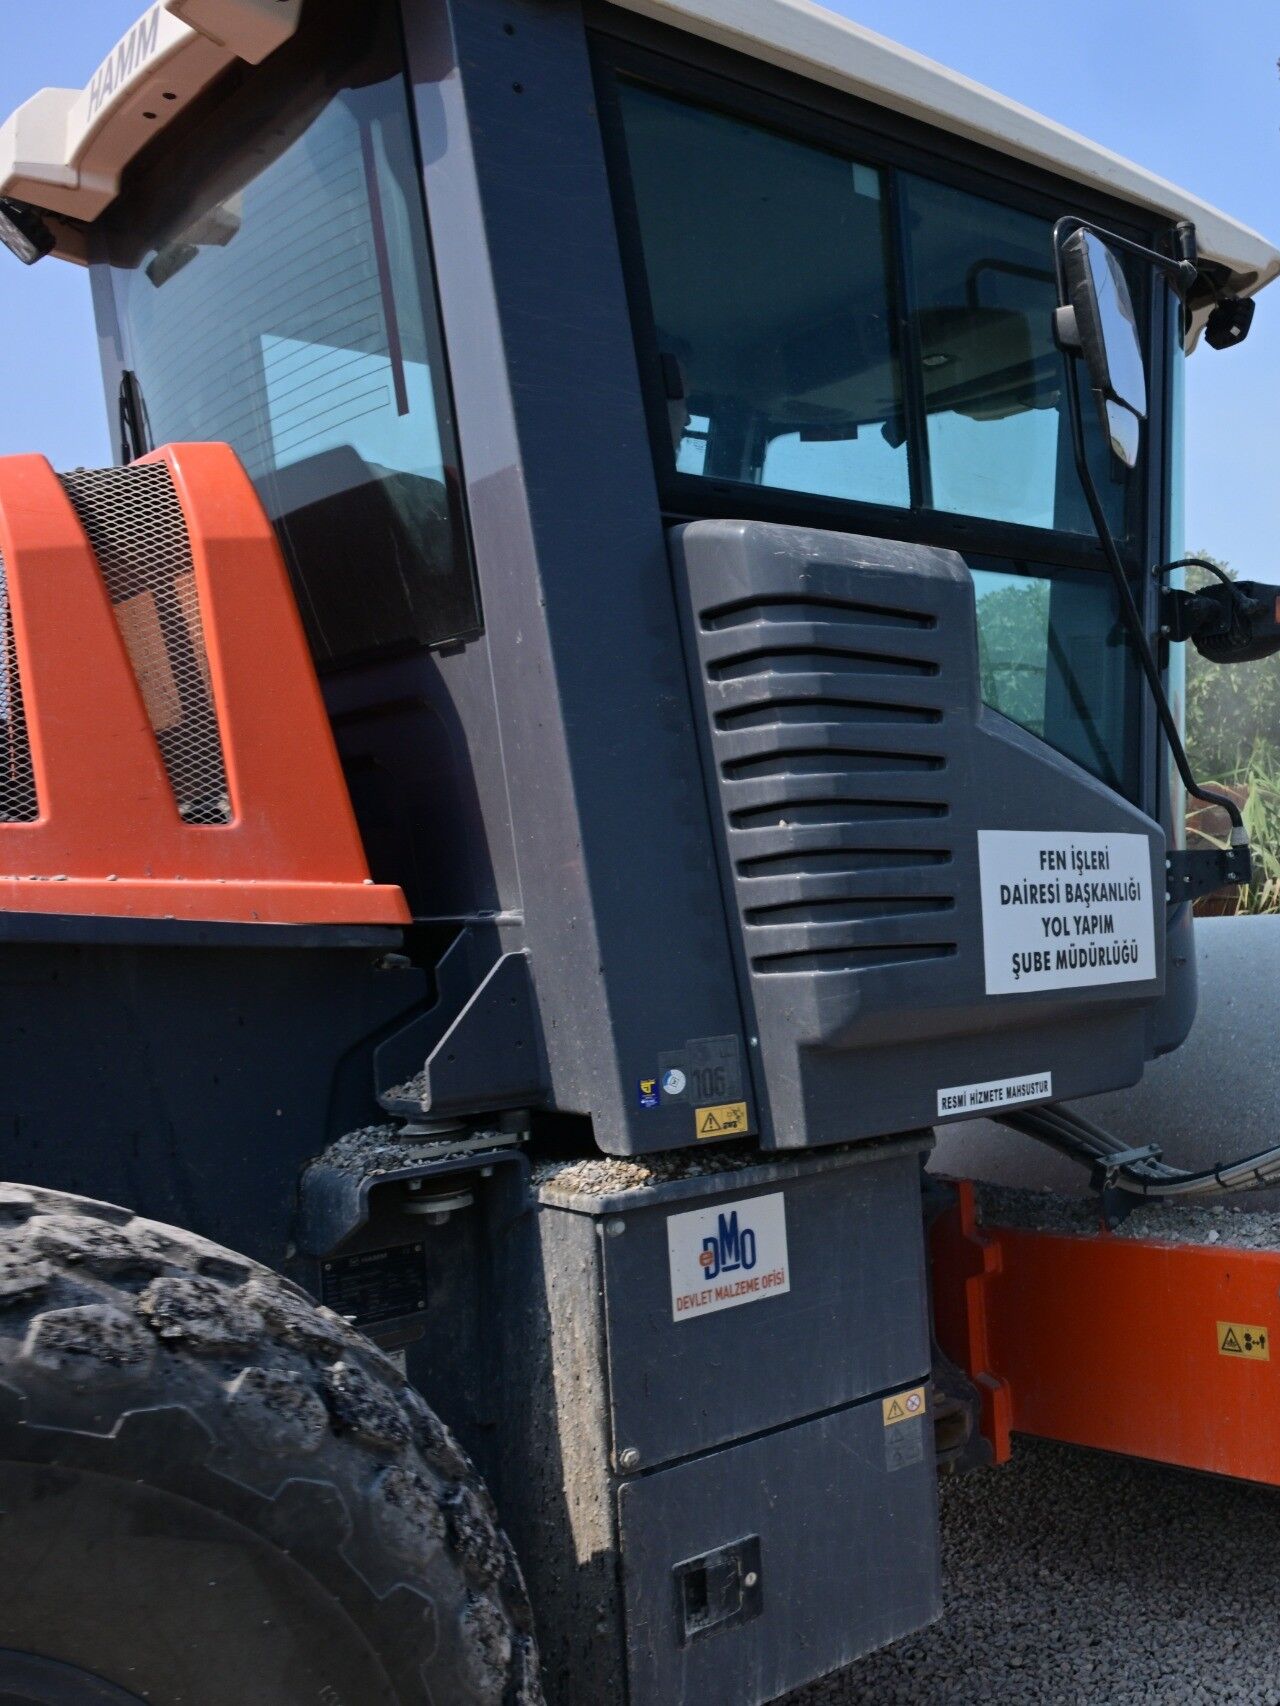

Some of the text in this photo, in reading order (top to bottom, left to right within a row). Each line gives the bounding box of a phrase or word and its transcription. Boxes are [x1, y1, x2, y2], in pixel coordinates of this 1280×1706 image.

[87, 4, 160, 122] HAMM
[1039, 844, 1110, 876] FEN İŞLERİ
[1000, 877, 1141, 908] DAİRESİ BAŞKANLIĞI
[1041, 914, 1114, 937] YOL YAPIM
[1012, 939, 1138, 980] ŞUBE MÜDÜRLÜĞÜ
[941, 1080, 1049, 1110] RESMİ HİZMETE MAHSUSTUR
[676, 1268, 785, 1312] DEVLET MALZEME OFİSİ
